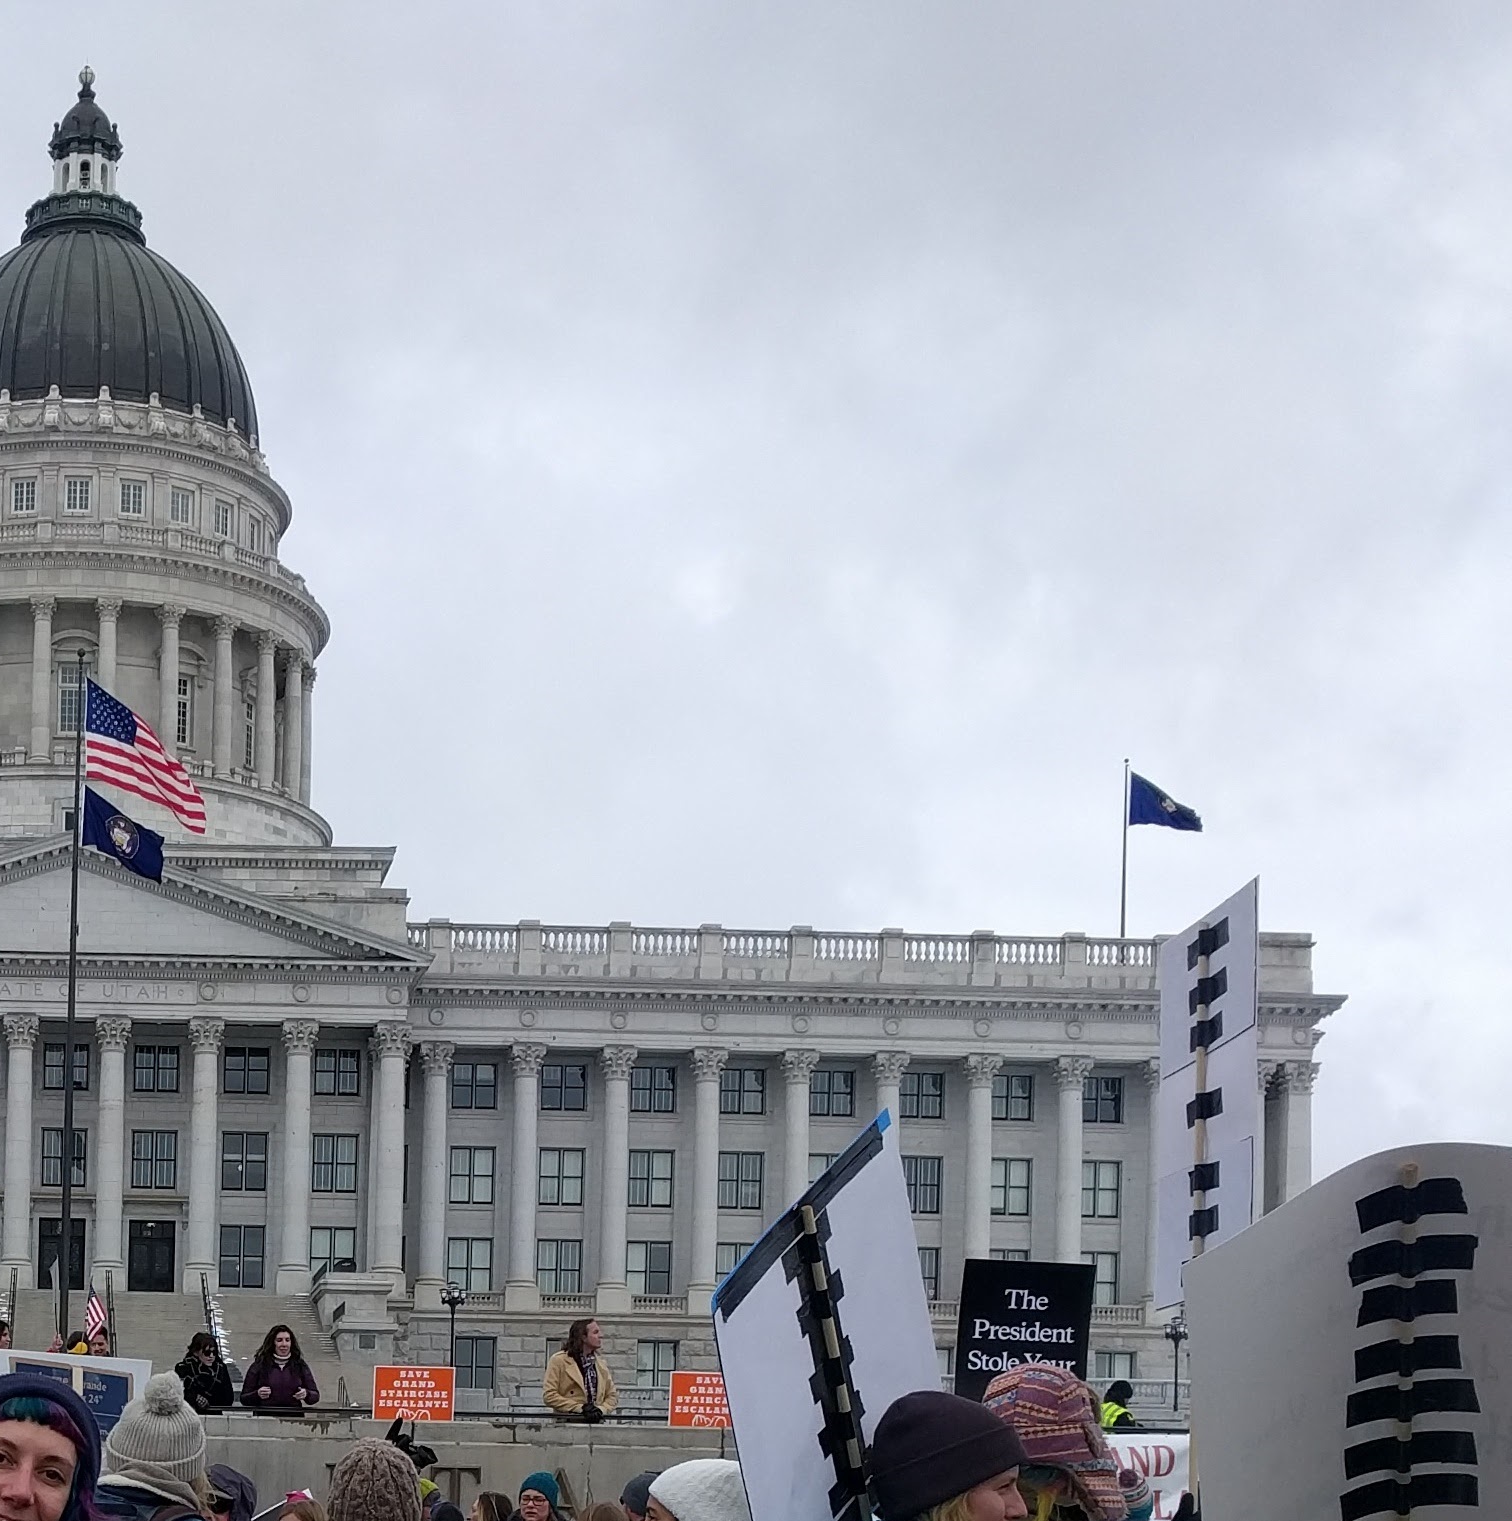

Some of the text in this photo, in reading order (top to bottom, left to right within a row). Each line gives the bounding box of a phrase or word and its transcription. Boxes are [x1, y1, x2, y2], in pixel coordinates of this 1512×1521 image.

[58, 981, 85, 998] OF
[102, 983, 169, 1000] UTAH
[1004, 1289, 1049, 1310] The
[972, 1319, 1076, 1344] President
[968, 1350, 1020, 1372] Stole
[393, 1380, 435, 1388] GRAND
[380, 1390, 448, 1398] STAIRCASE
[689, 1386, 726, 1394] GRAN
[379, 1400, 449, 1408] ESCALANTE
[676, 1395, 728, 1404] STAIRCA
[675, 1405, 729, 1414] ESCALAN
